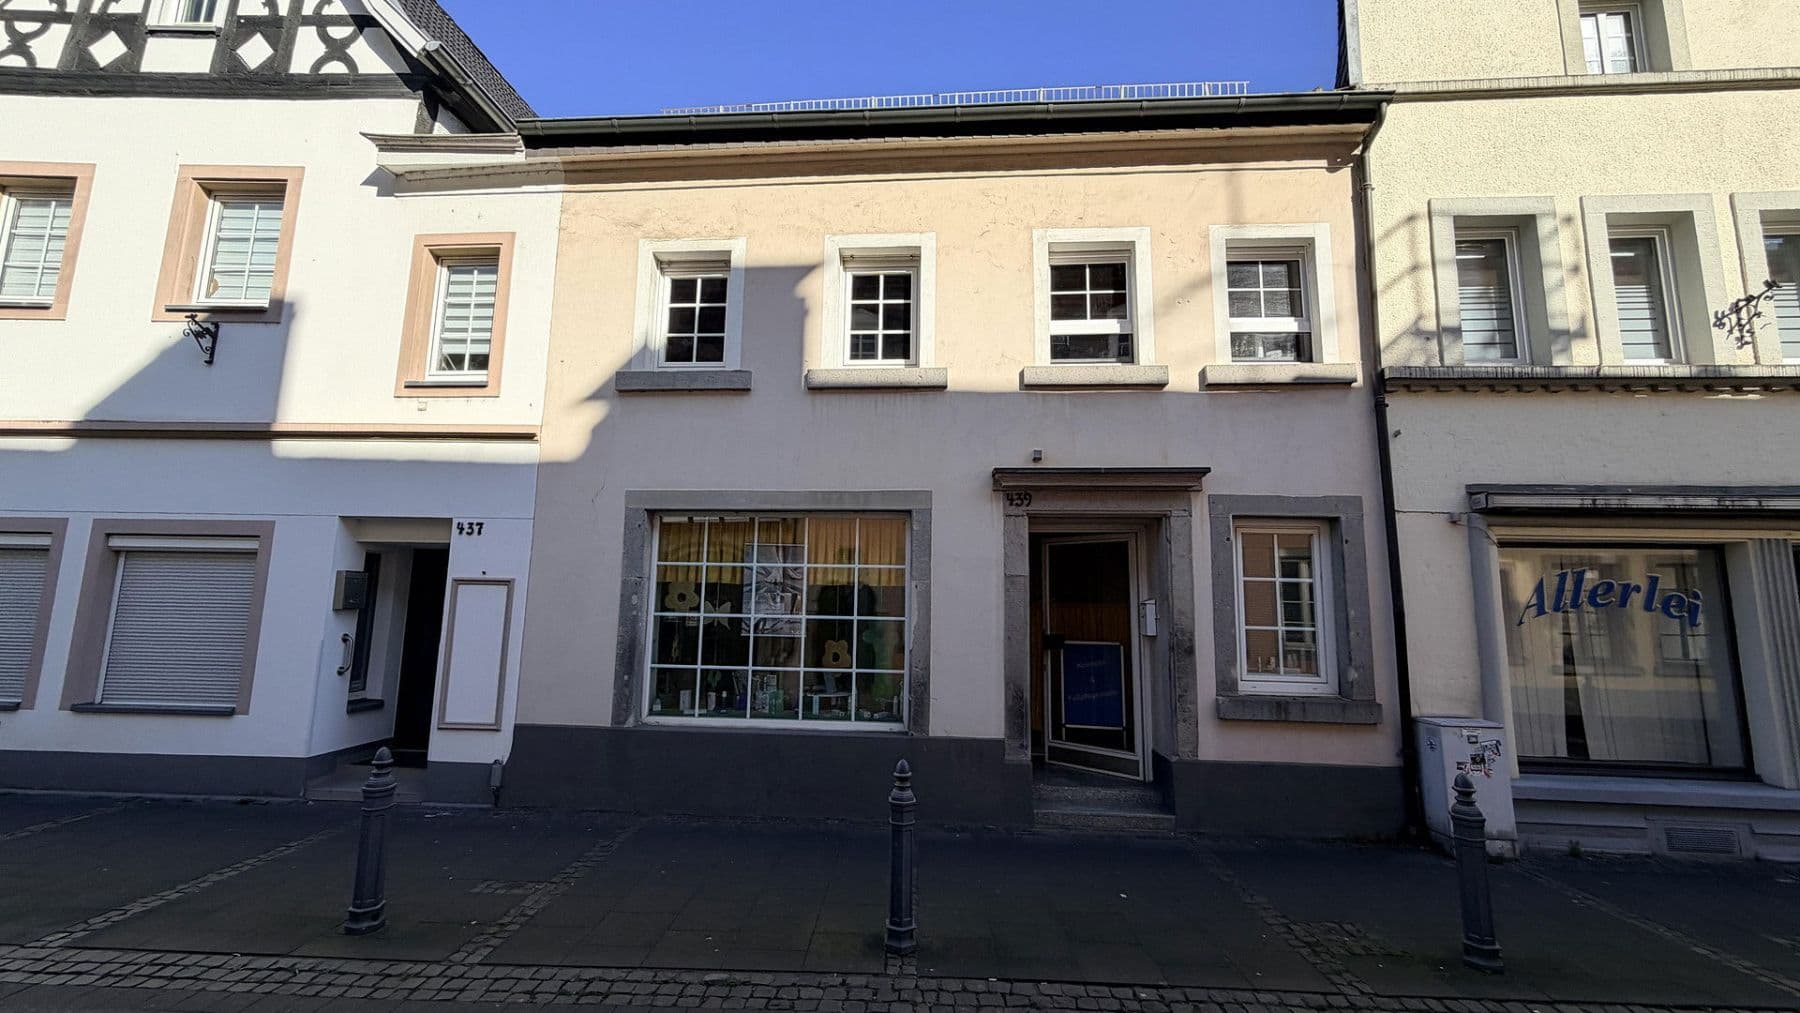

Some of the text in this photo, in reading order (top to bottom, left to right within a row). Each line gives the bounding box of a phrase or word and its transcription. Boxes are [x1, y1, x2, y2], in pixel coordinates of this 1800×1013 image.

[1006, 493, 1033, 508] 439
[456, 522, 485, 536] 437
[1516, 567, 1704, 628] Allerlei
